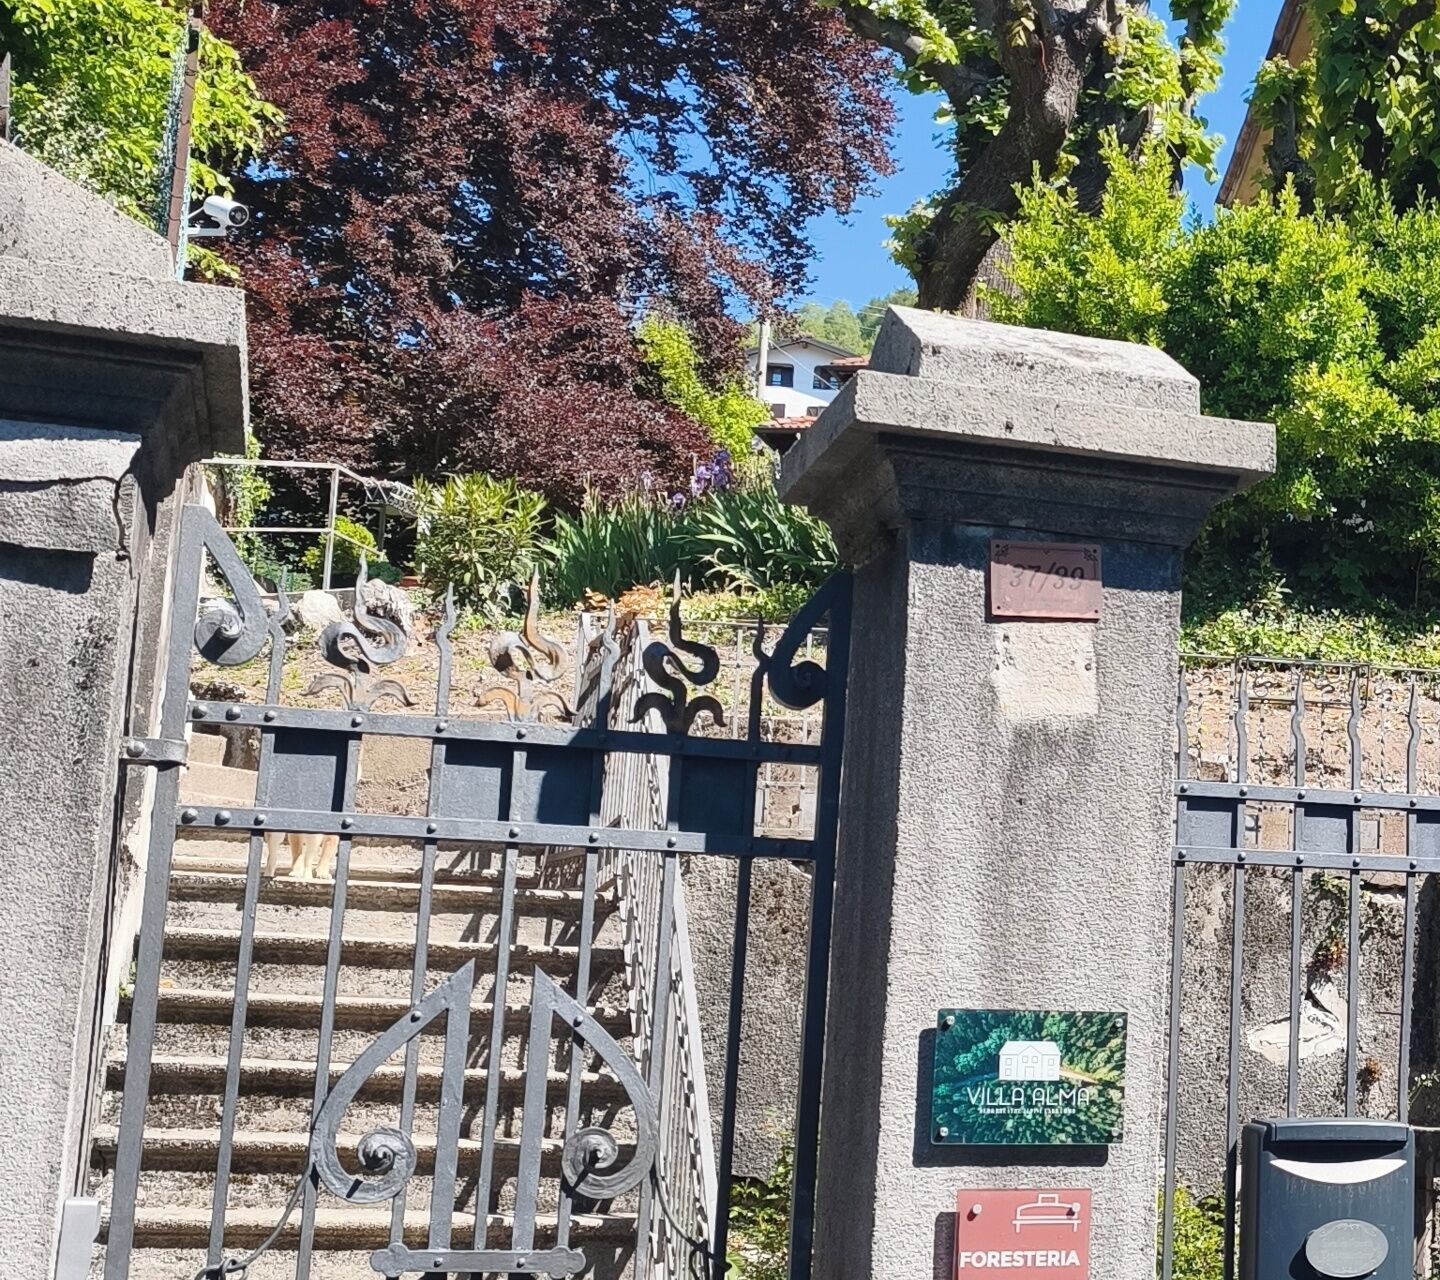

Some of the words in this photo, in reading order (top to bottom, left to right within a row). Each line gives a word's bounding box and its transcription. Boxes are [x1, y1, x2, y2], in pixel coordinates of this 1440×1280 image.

[967, 1087, 1025, 1106] VILLA
[1032, 1087, 1090, 1106] ALMA
[959, 1250, 1081, 1268] FORESTERIA
